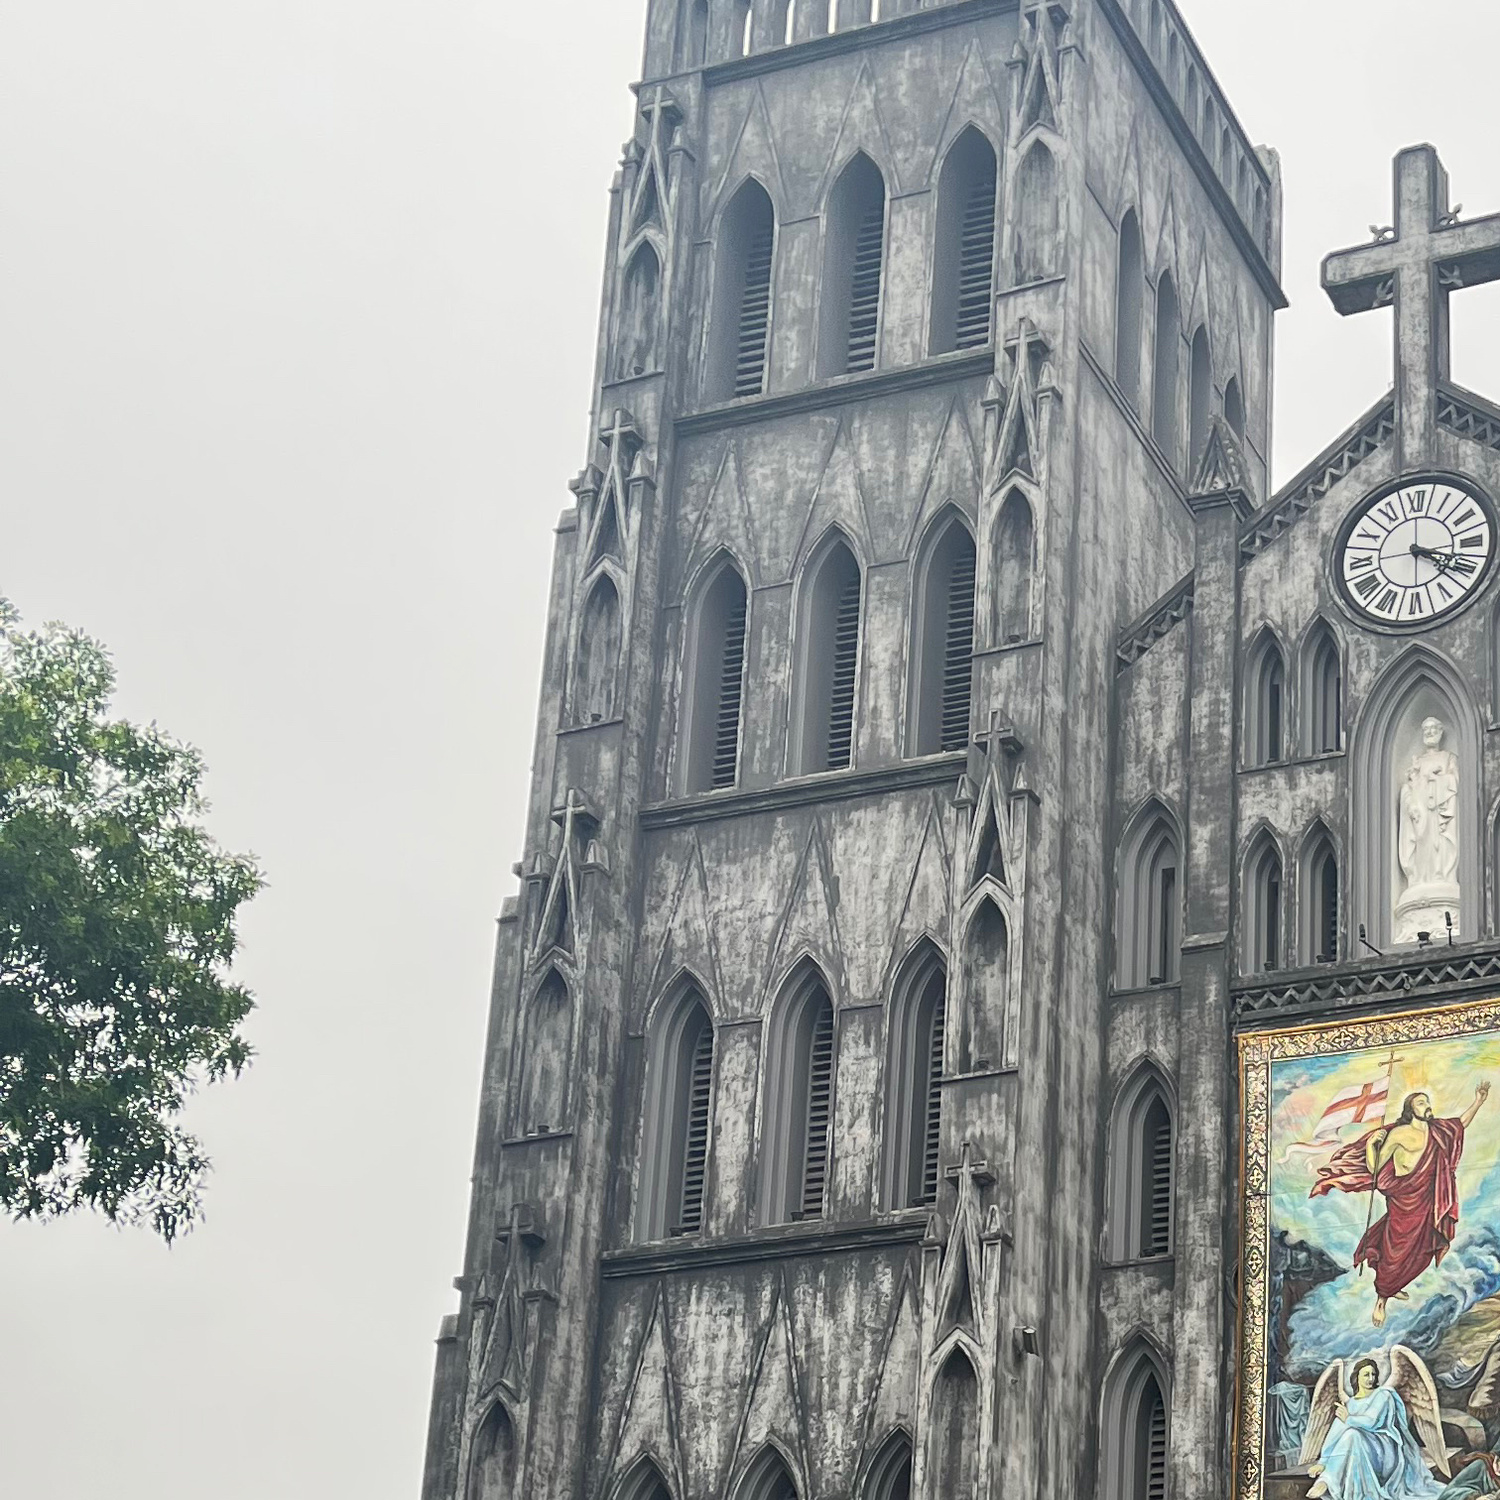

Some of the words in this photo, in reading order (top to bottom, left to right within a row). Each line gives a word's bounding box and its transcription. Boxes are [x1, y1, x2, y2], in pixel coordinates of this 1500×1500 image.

[1406, 490, 1426, 513] XII
[1436, 492, 1451, 513] I
[1377, 501, 1399, 524] XI
[1356, 527, 1380, 543] X
[1350, 554, 1373, 571] IX
[1436, 582, 1453, 602] V
